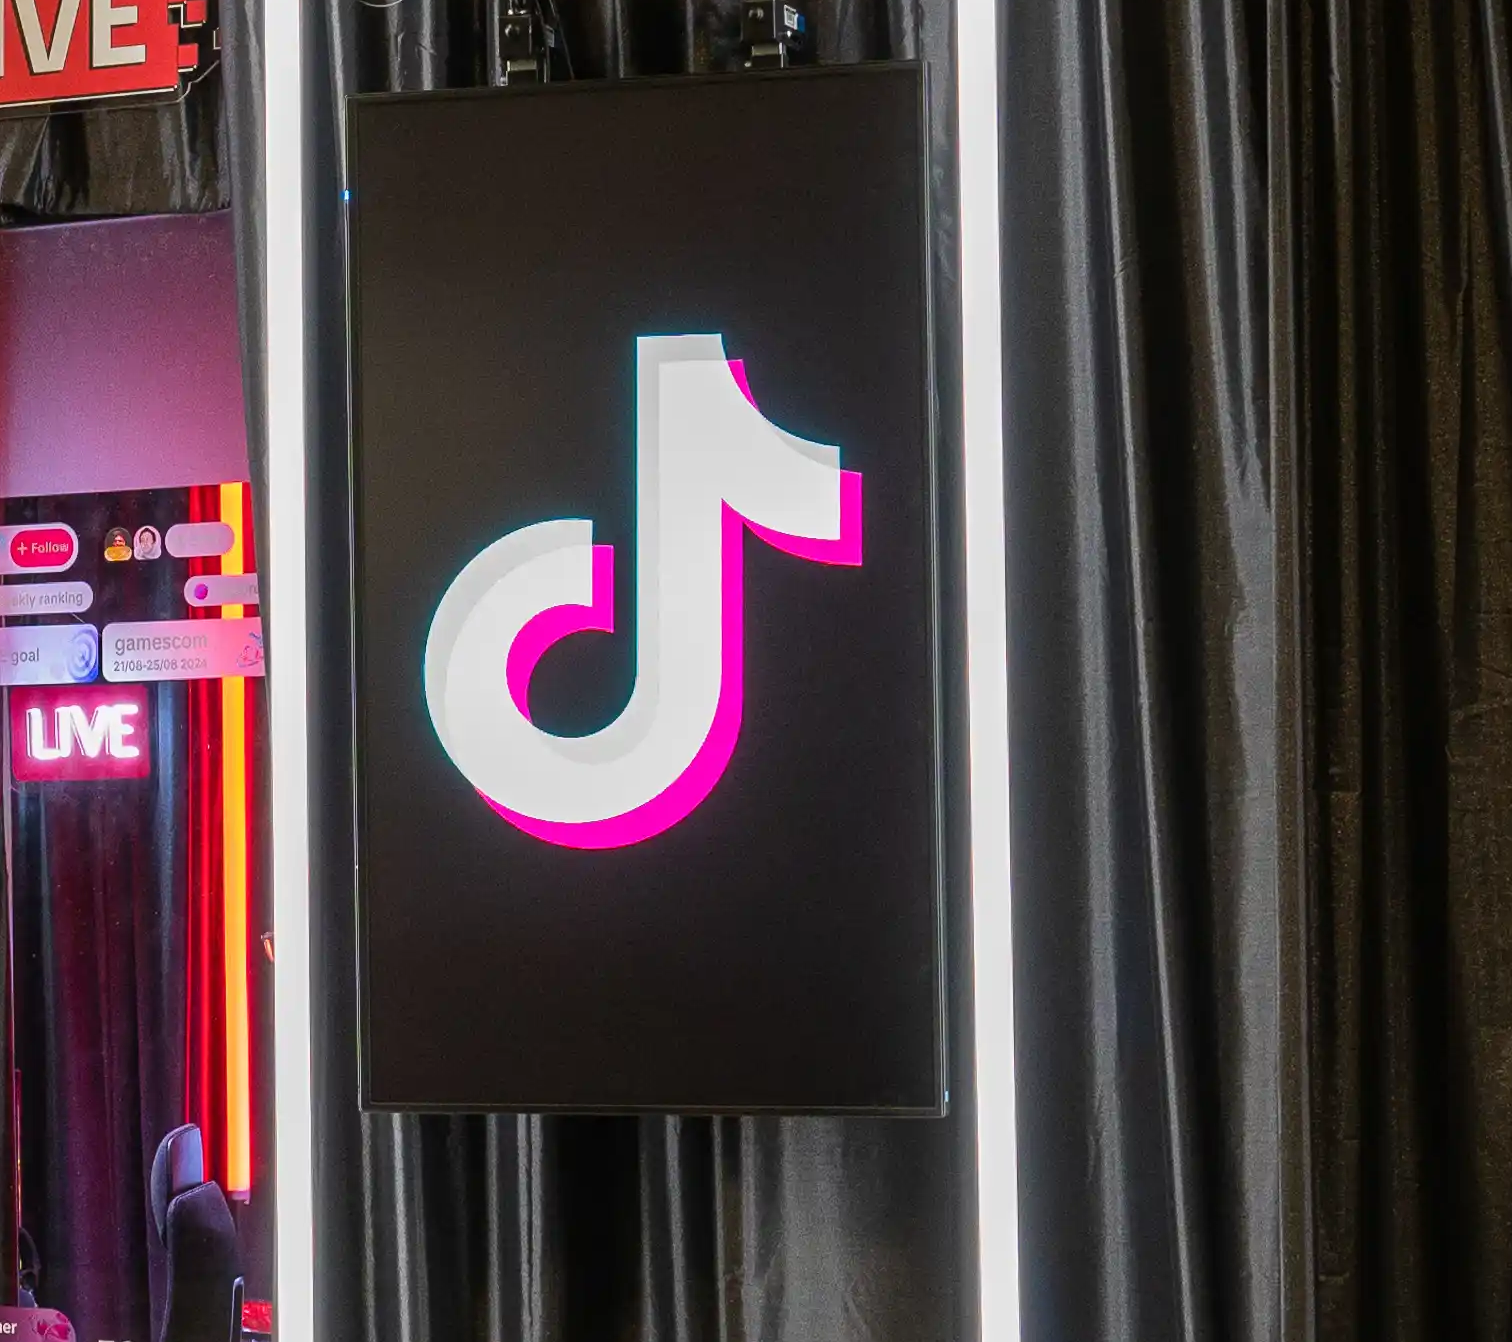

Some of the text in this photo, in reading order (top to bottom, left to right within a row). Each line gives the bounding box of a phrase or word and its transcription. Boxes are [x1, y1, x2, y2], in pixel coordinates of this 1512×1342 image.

[31, 543, 69, 554] Follow
[39, 592, 83, 605] ranking
[115, 634, 207, 656] gamescom
[12, 648, 39, 665] goal
[113, 660, 177, 672] 21/08-25/08
[25, 703, 141, 761] LIVE
